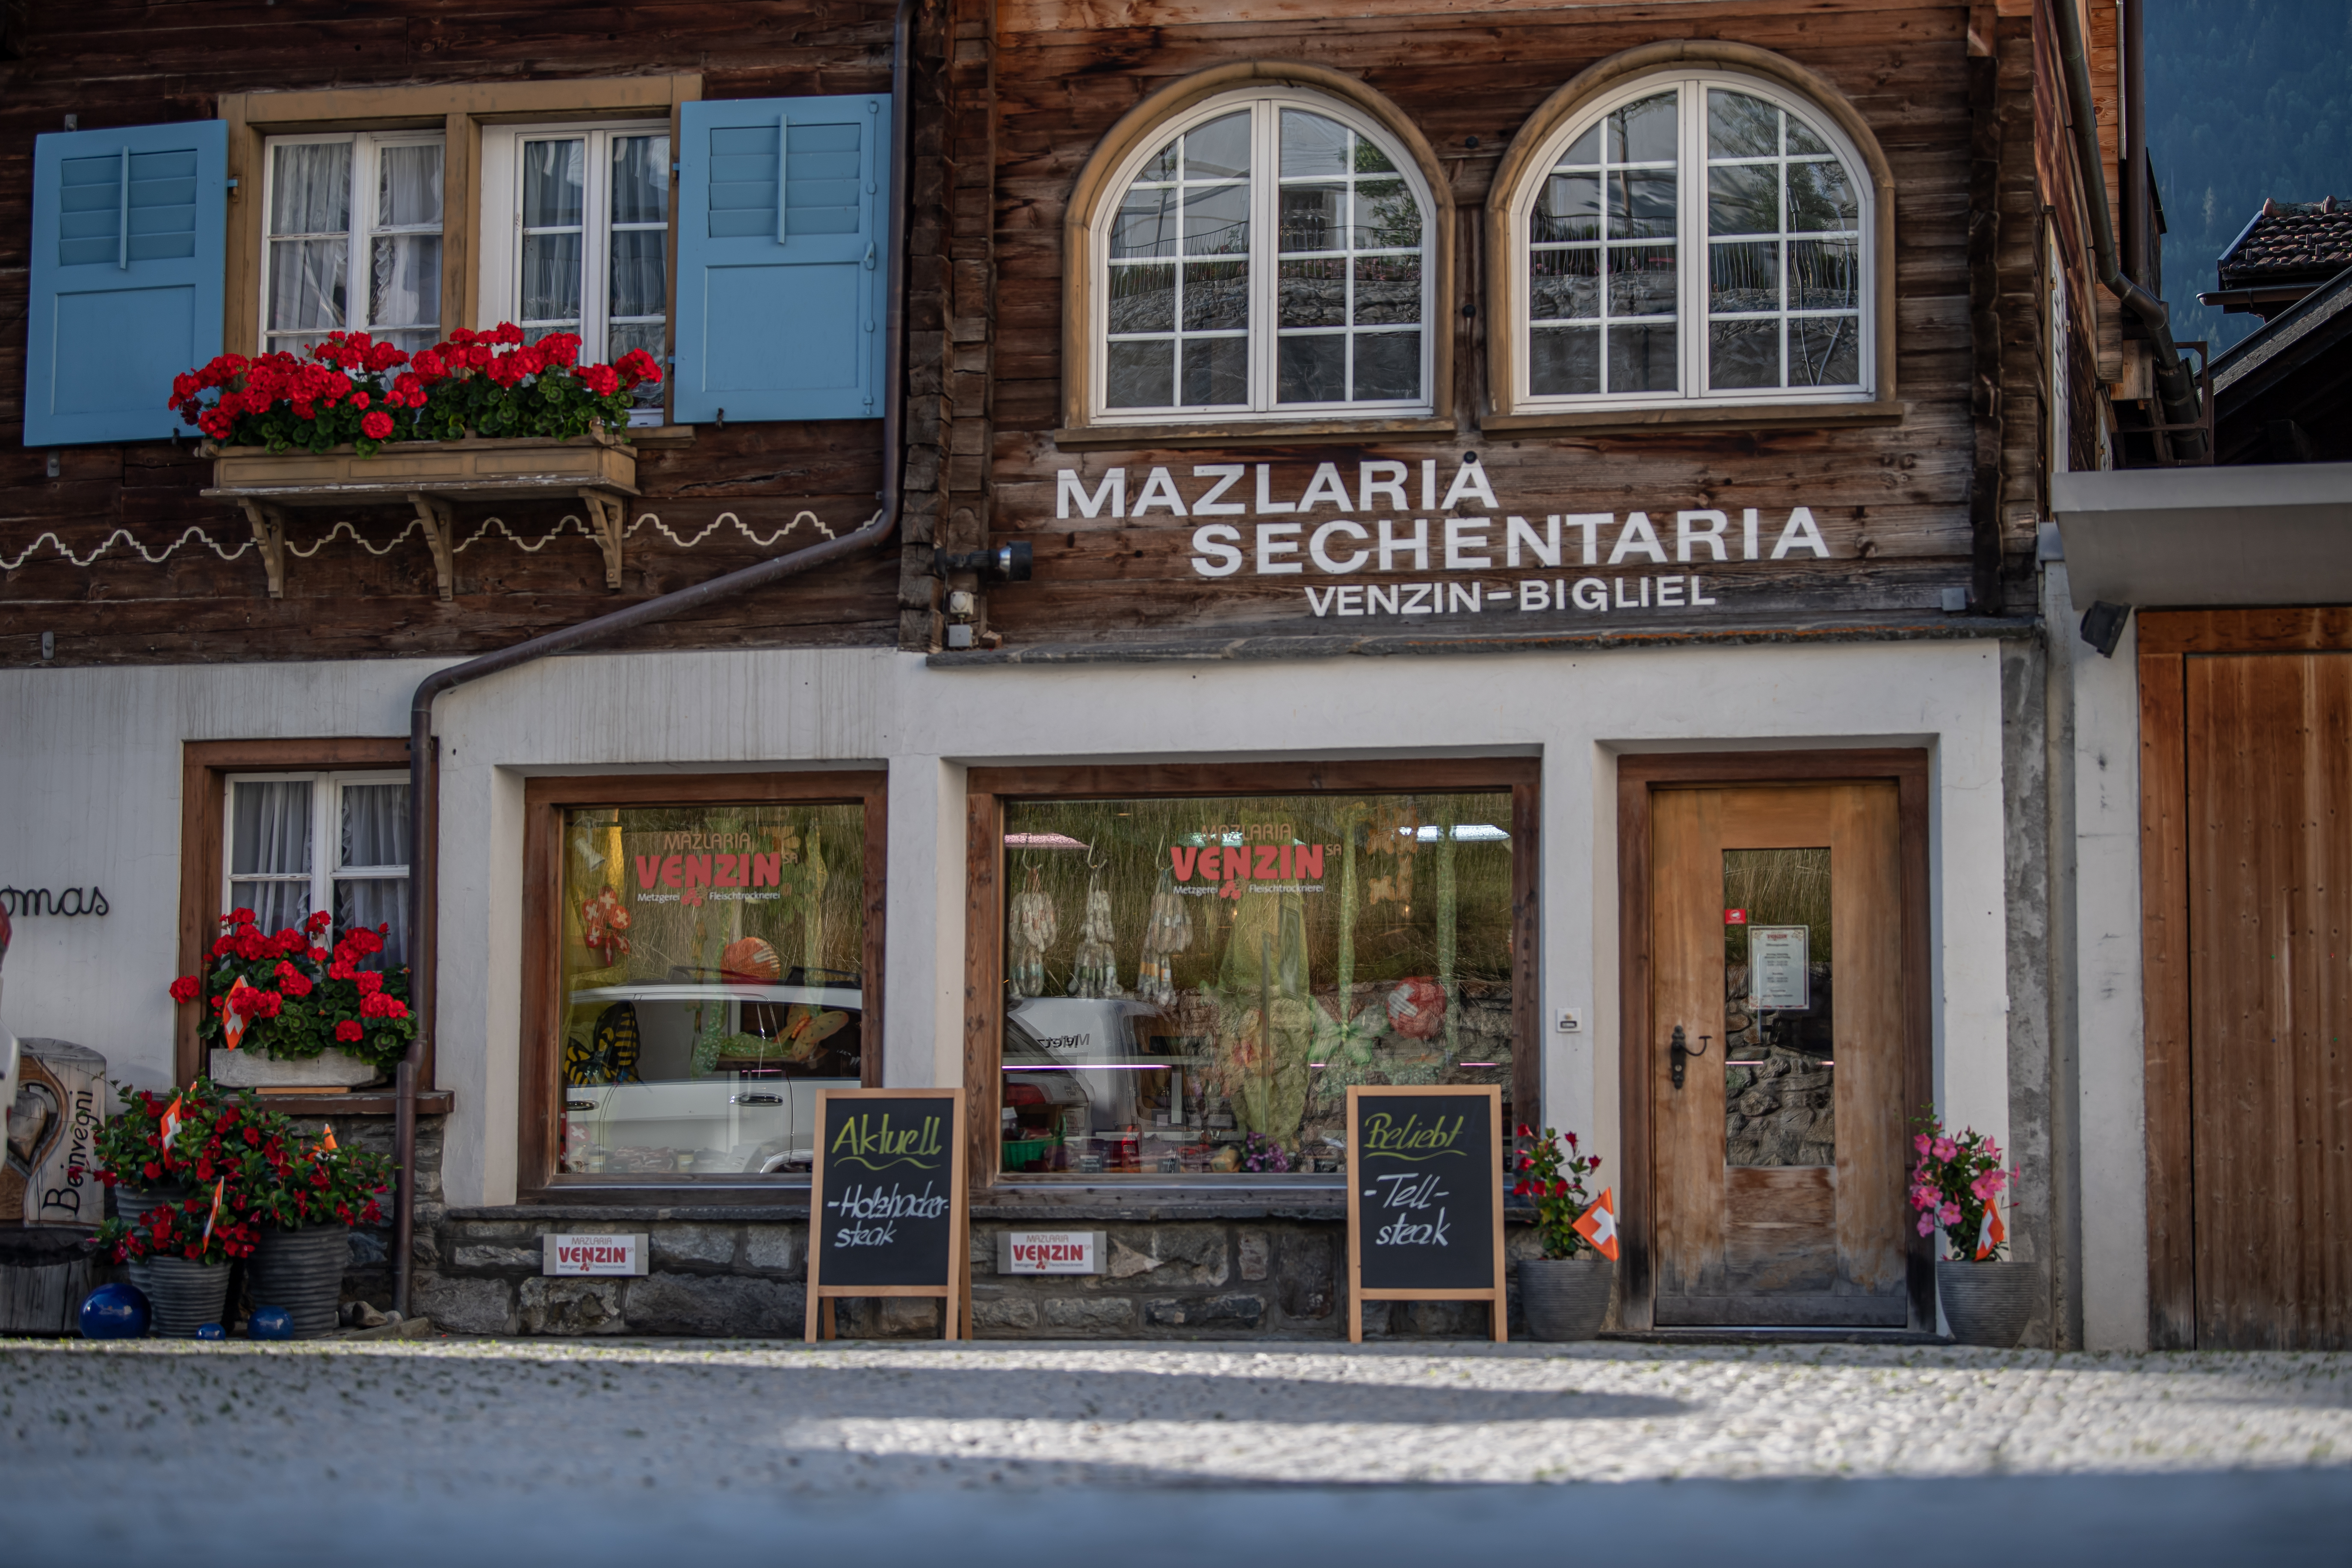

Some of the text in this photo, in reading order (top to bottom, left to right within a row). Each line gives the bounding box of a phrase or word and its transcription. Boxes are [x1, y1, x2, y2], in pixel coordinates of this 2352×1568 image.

[1056, 457, 1499, 519] MAZLARIA
[1191, 506, 1830, 577] SECHENTARIA
[1303, 575, 1716, 617] VENZIN-BIGLIEL
[663, 832, 752, 850] MAZLARIA
[1201, 823, 1292, 841] MAZLARIA
[636, 853, 780, 889] VENZIN
[1170, 844, 1342, 882] VENZIN SA
[637, 890, 780, 904] Metzgerei Fleischtrocknerei
[1173, 883, 1324, 896] Metzgerei Fleischtrocknerei
[831, 1113, 942, 1155] Aktuell
[1363, 1112, 1464, 1150] Beliebt
[42, 1090, 101, 1216] Benvegni
[571, 1237, 612, 1245] MAZLARIA
[834, 1220, 897, 1247] steak
[1026, 1234, 1070, 1243] MAZLARIA
[1376, 1206, 1451, 1246] steak
[558, 1246, 626, 1263] VENZIN
[1013, 1244, 1084, 1261] VENZIN
